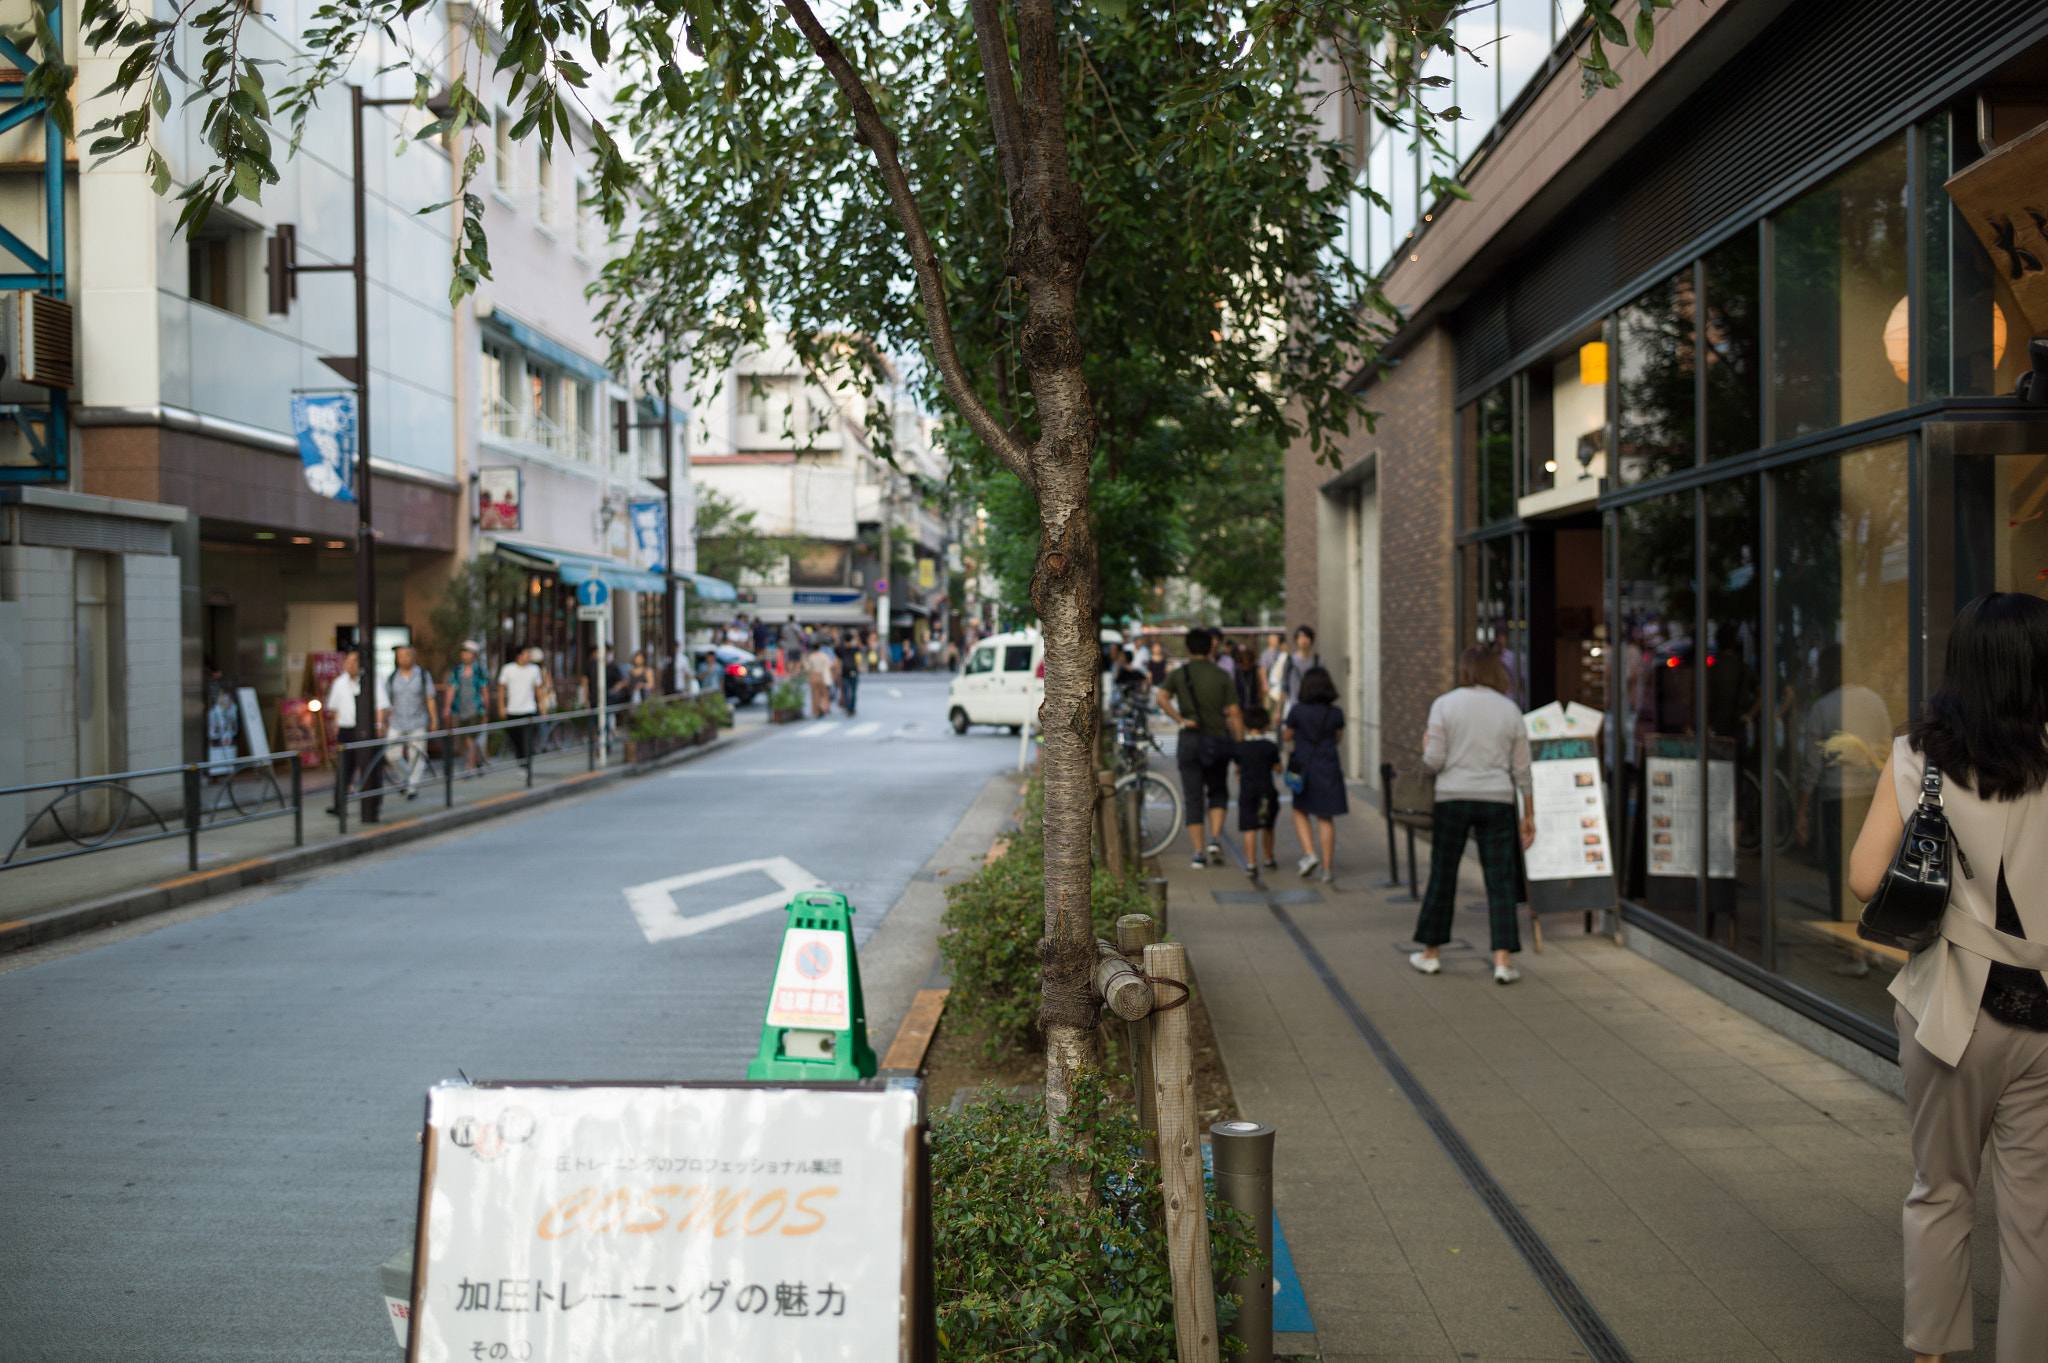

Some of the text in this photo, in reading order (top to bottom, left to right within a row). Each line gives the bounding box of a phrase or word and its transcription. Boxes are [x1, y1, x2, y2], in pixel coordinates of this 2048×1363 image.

[455, 1277, 845, 1317] 加圧トレーニングの魅力
